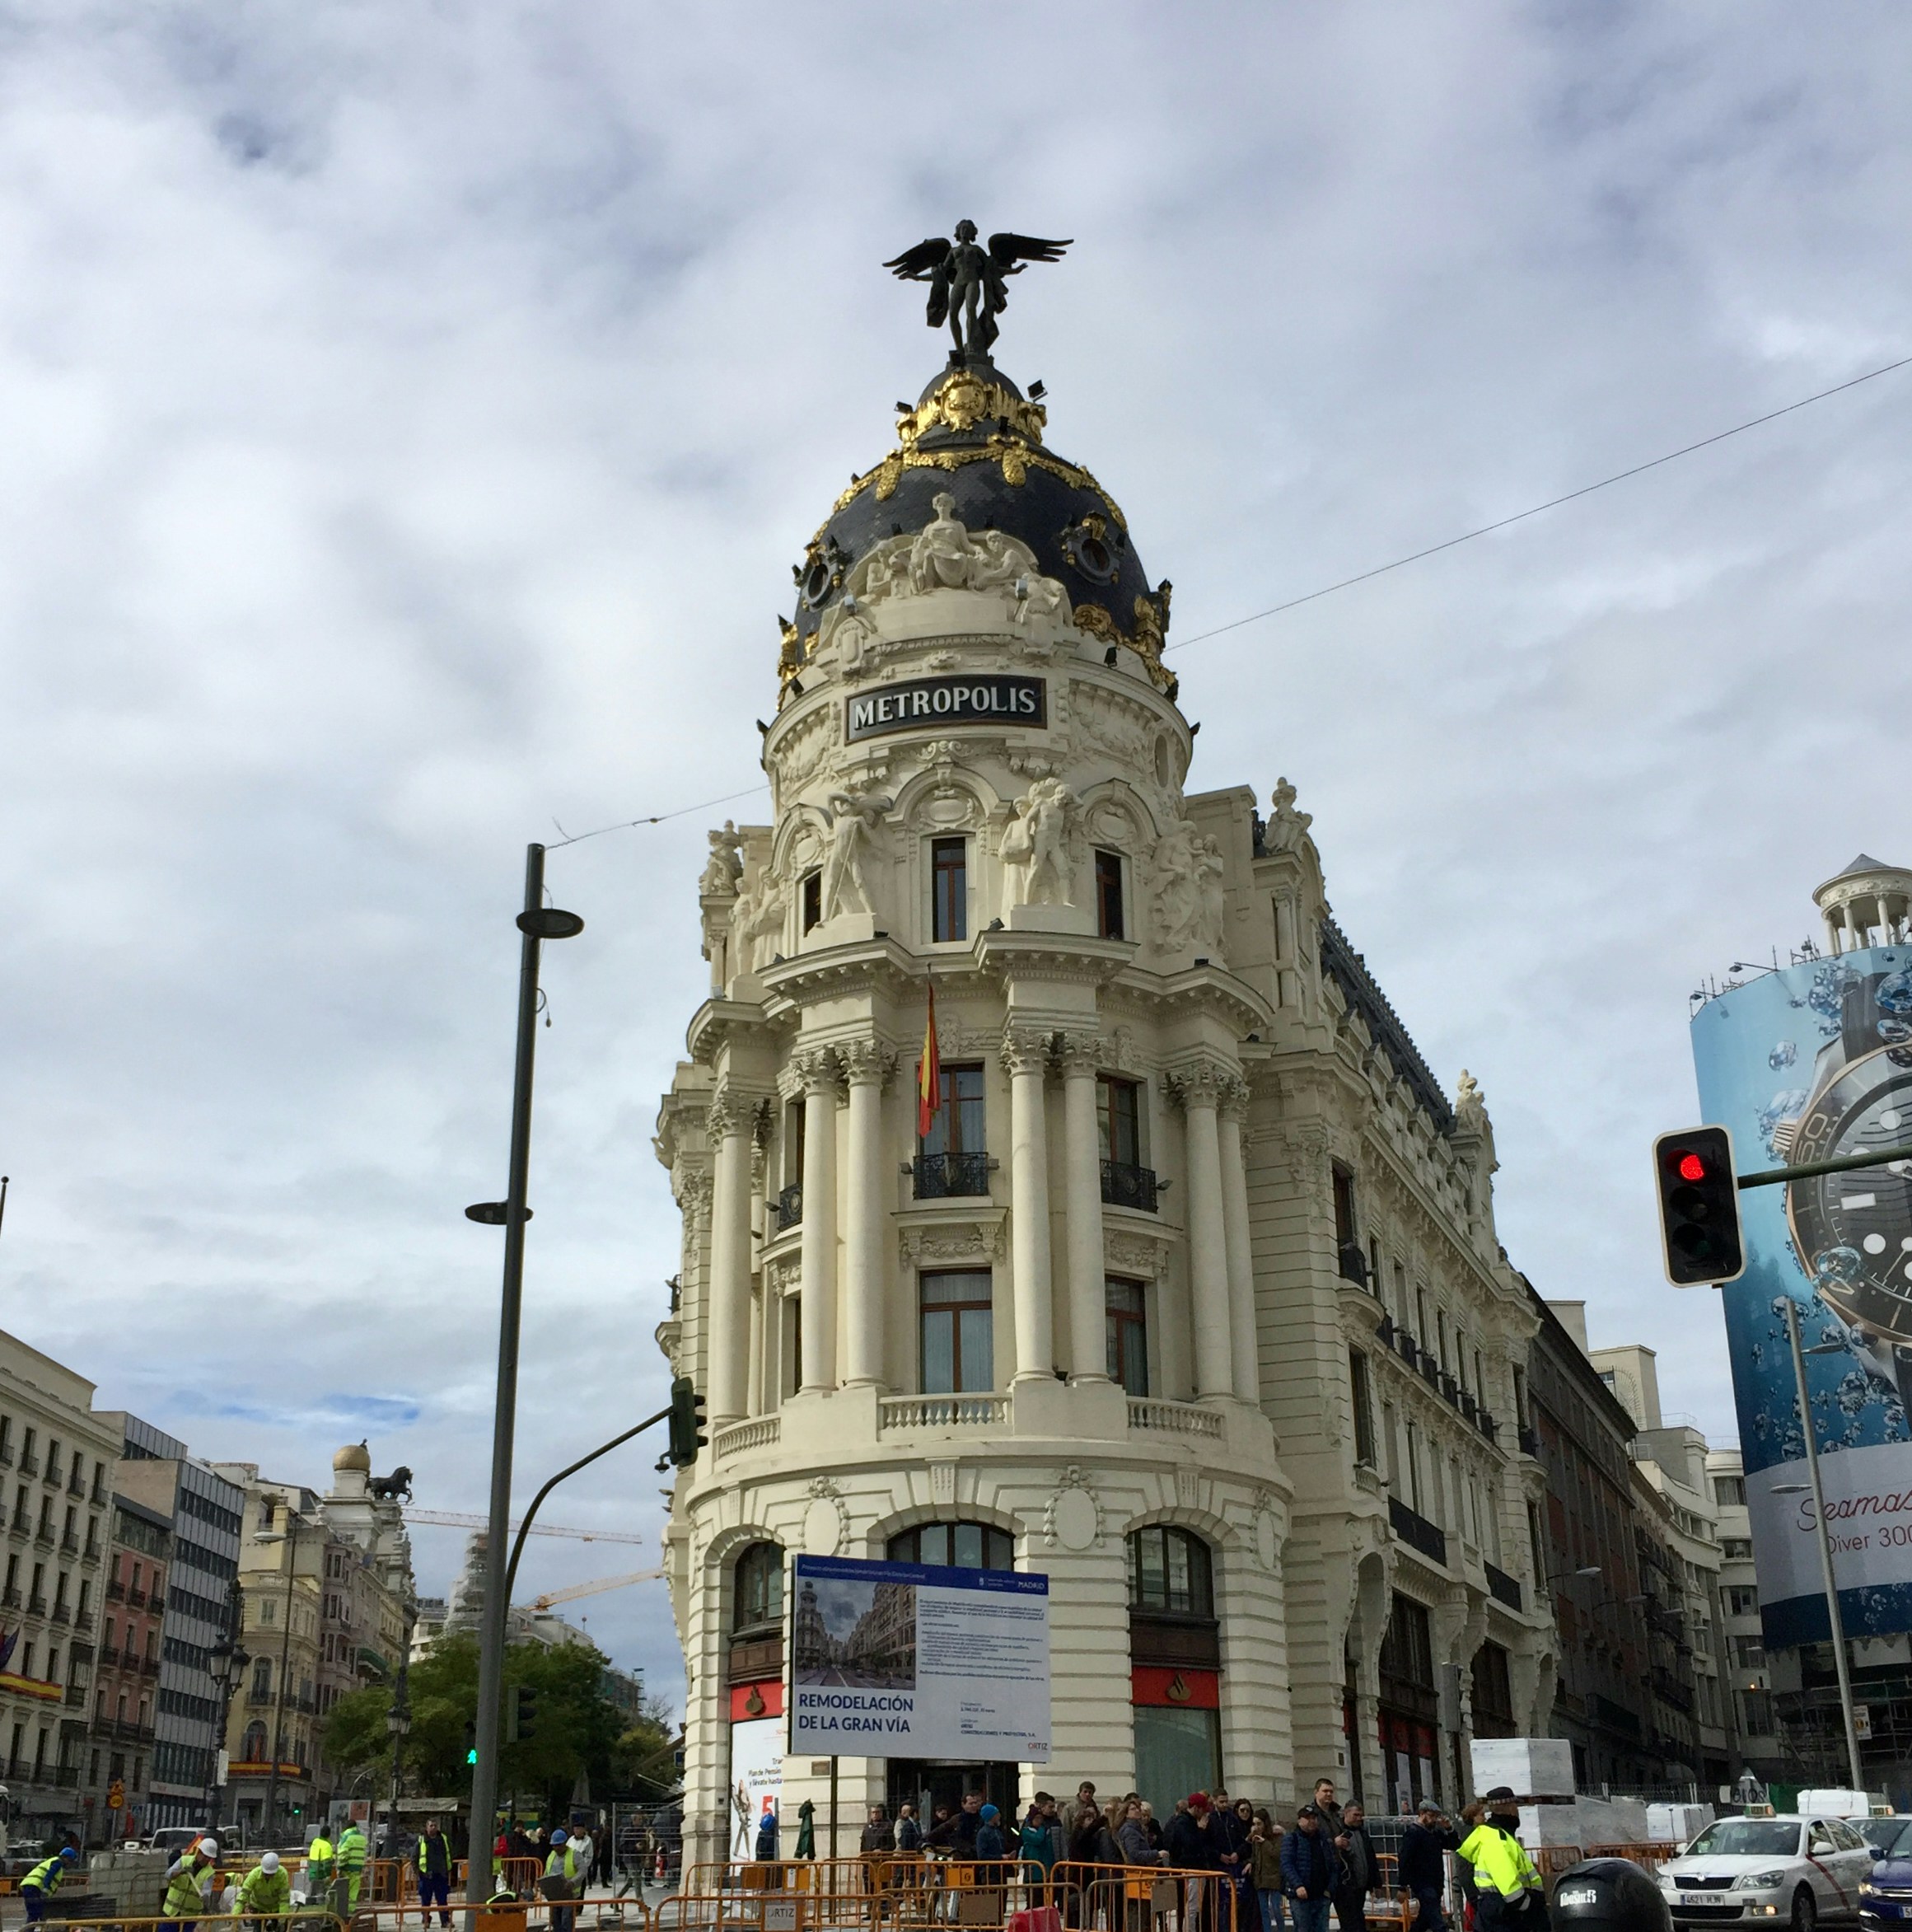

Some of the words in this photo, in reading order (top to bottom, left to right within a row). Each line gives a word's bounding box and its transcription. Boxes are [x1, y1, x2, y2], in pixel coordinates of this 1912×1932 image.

[854, 686, 1035, 729] METROPOLIS
[1017, 1581, 1045, 1590] MADRID
[799, 1693, 914, 1712] REMODELACIÓN
[799, 1715, 818, 1729] DE
[820, 1717, 838, 1730] LA
[841, 1718, 883, 1732] GRAN
[888, 1715, 911, 1733] VÍA
[1028, 1742, 1048, 1751] ORTIZ
